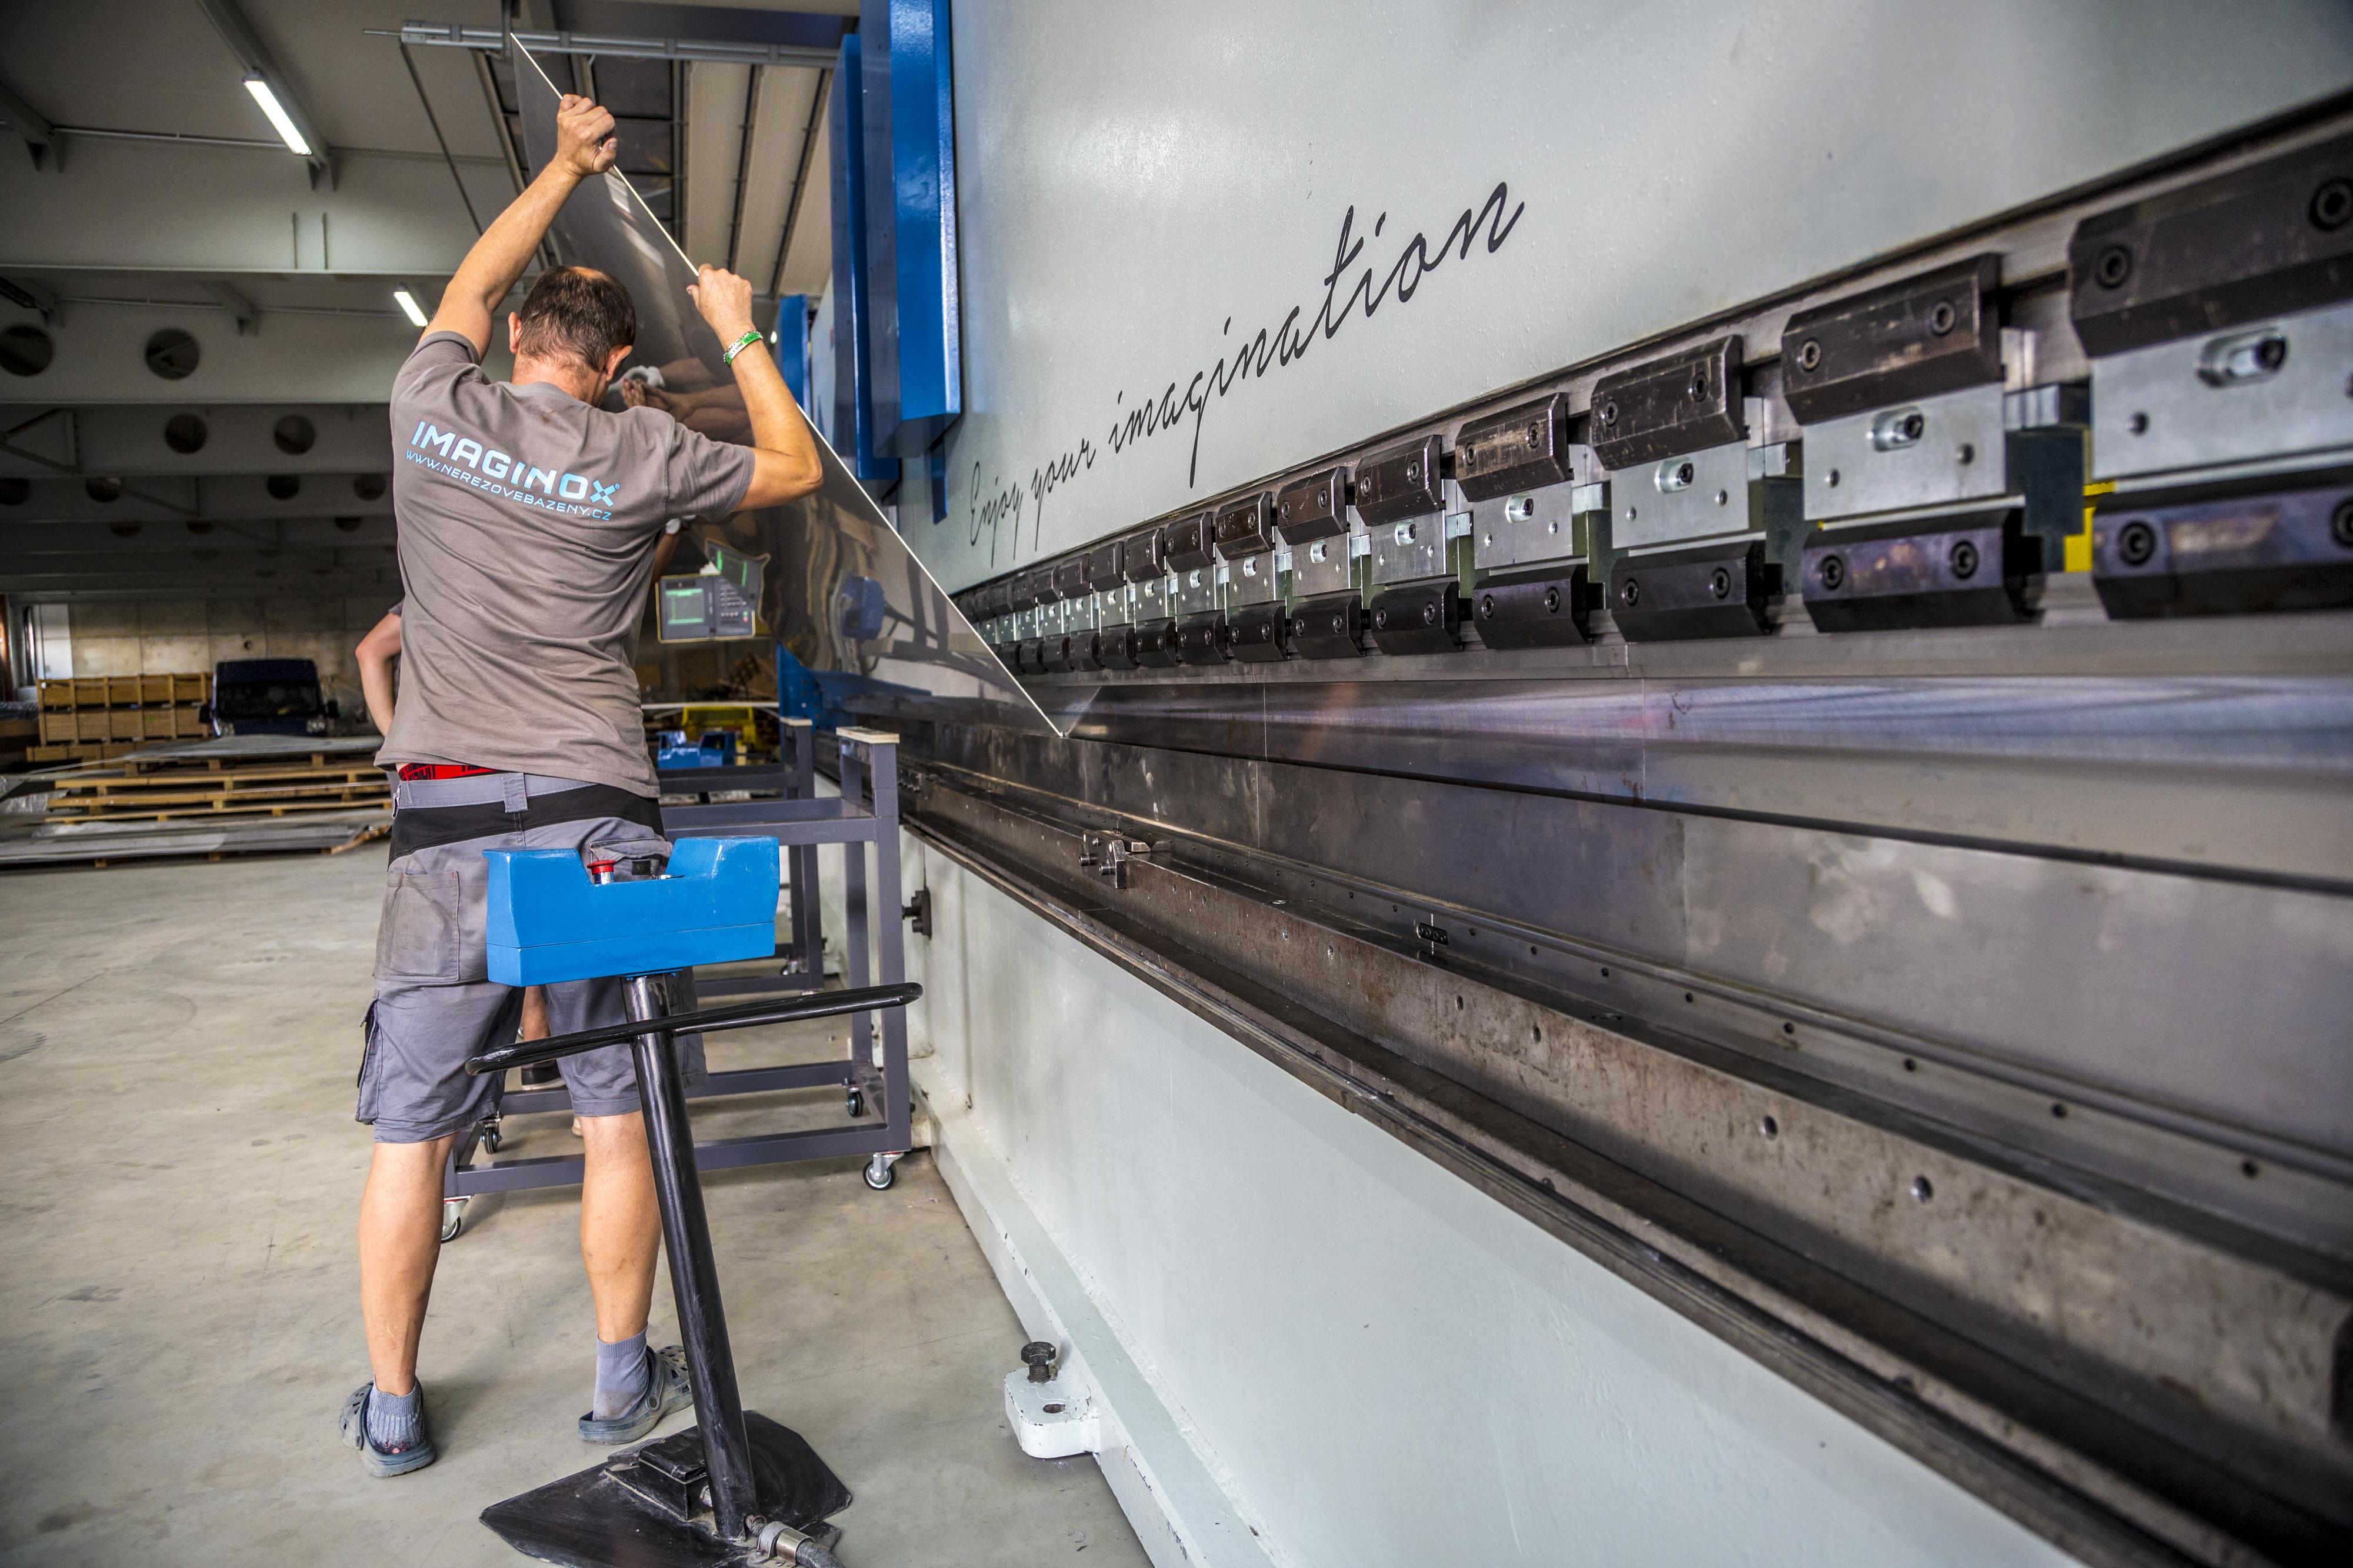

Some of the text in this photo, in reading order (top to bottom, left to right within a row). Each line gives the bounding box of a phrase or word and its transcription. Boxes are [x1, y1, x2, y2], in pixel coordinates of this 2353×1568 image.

[406, 449, 612, 521] WWW.NEREZOVEBAZENY.CZ
[970, 182, 1525, 569] Enjoy your imagination
